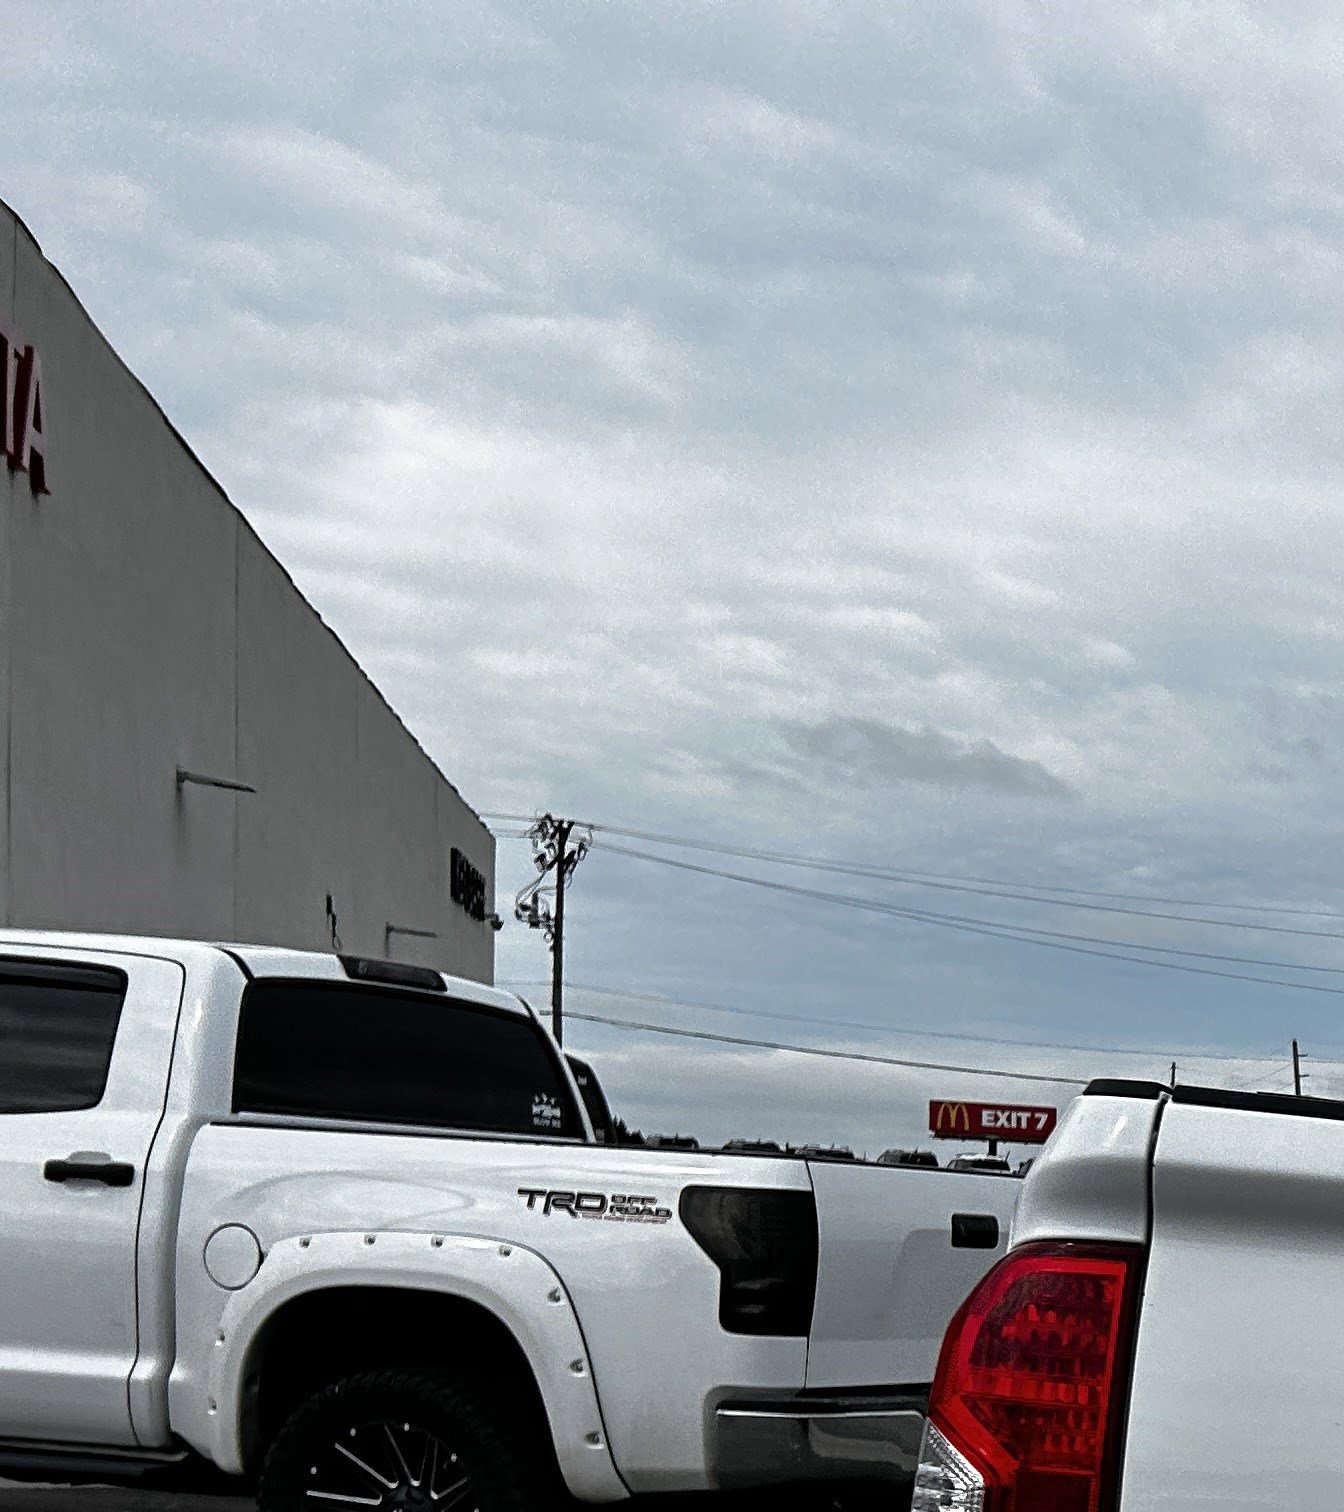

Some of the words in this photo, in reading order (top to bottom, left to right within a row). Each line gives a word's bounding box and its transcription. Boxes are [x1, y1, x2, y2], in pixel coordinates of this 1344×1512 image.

[981, 1108, 1031, 1130] EXIT
[1034, 1111, 1049, 1131] 7
[517, 1187, 608, 1219] TRD
[609, 1205, 673, 1220] ROAD
